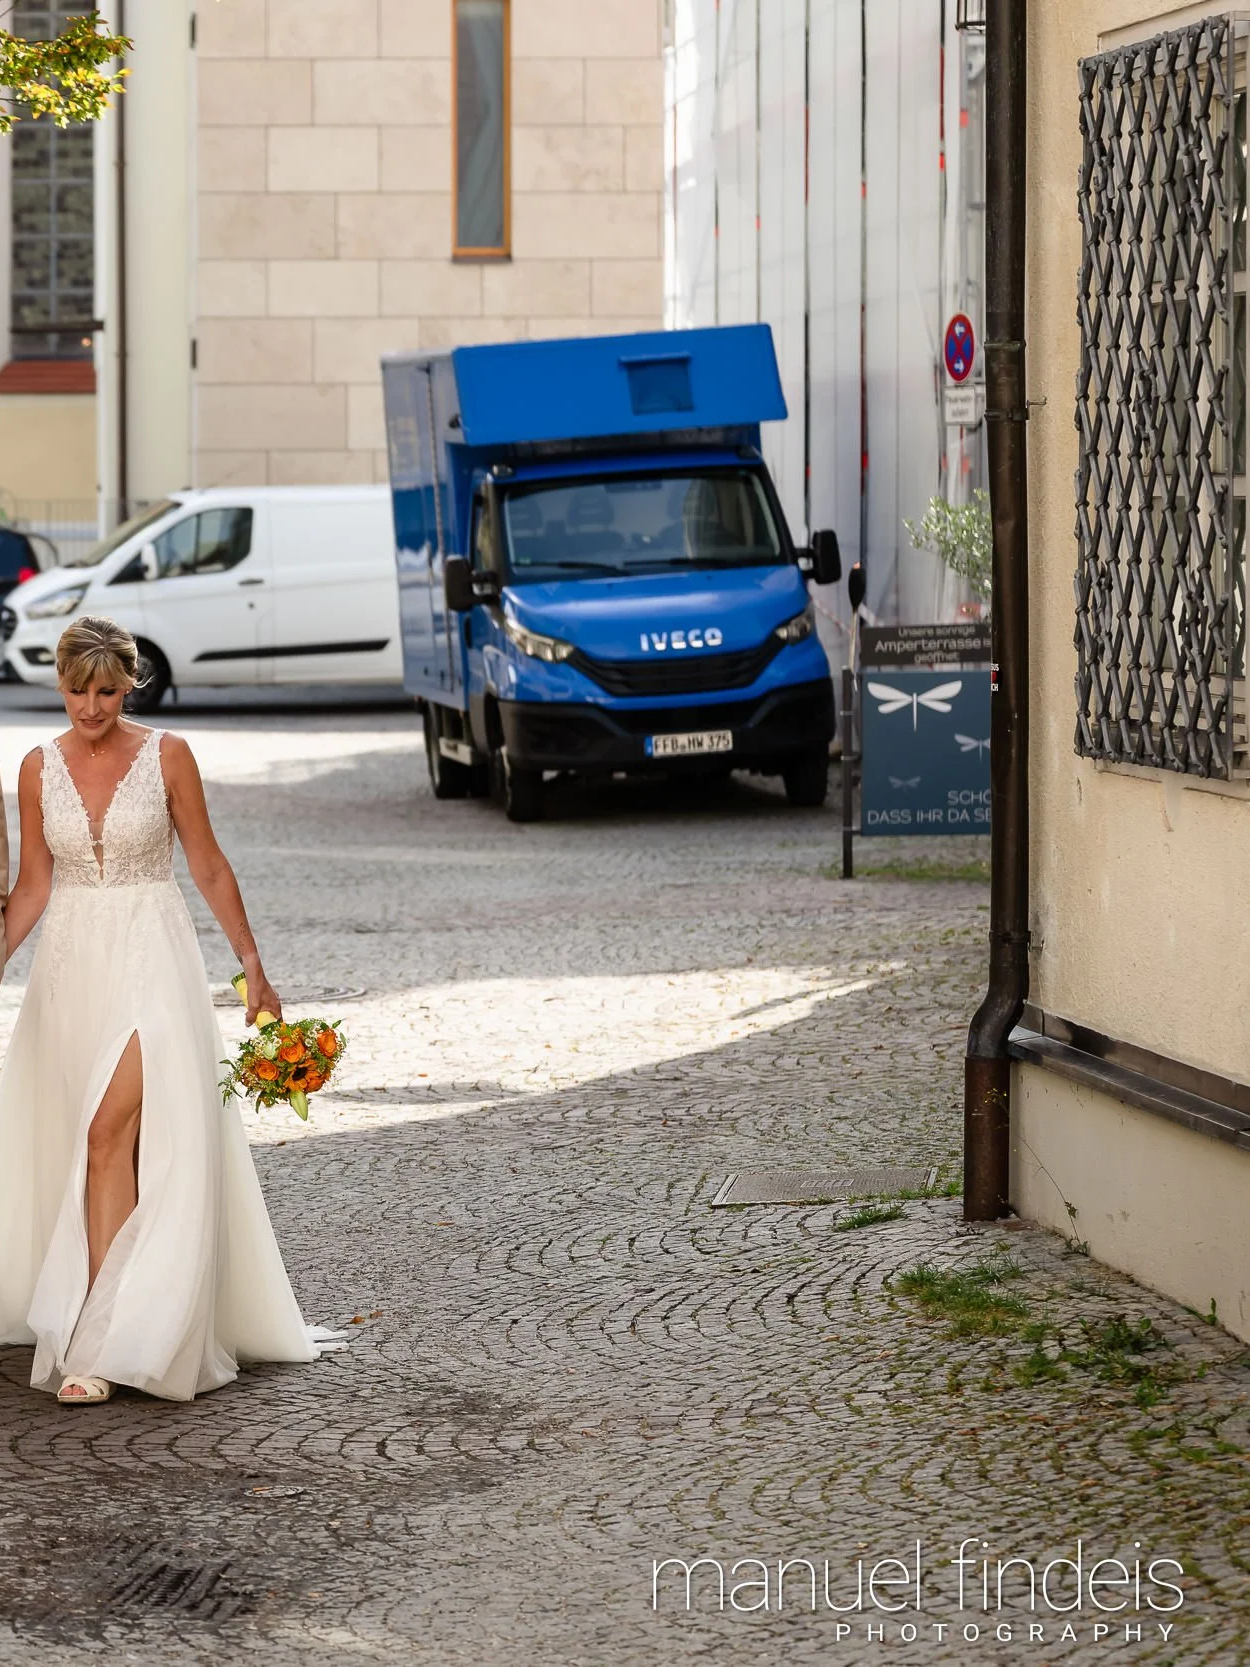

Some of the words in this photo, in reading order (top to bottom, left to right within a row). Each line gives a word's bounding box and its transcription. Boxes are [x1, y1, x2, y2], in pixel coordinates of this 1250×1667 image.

[640, 627, 723, 652] IVECO
[875, 638, 981, 654] Amperterrasse
[867, 808, 912, 825] DASS
[916, 808, 943, 823] IHR
[948, 808, 970, 823] DA
